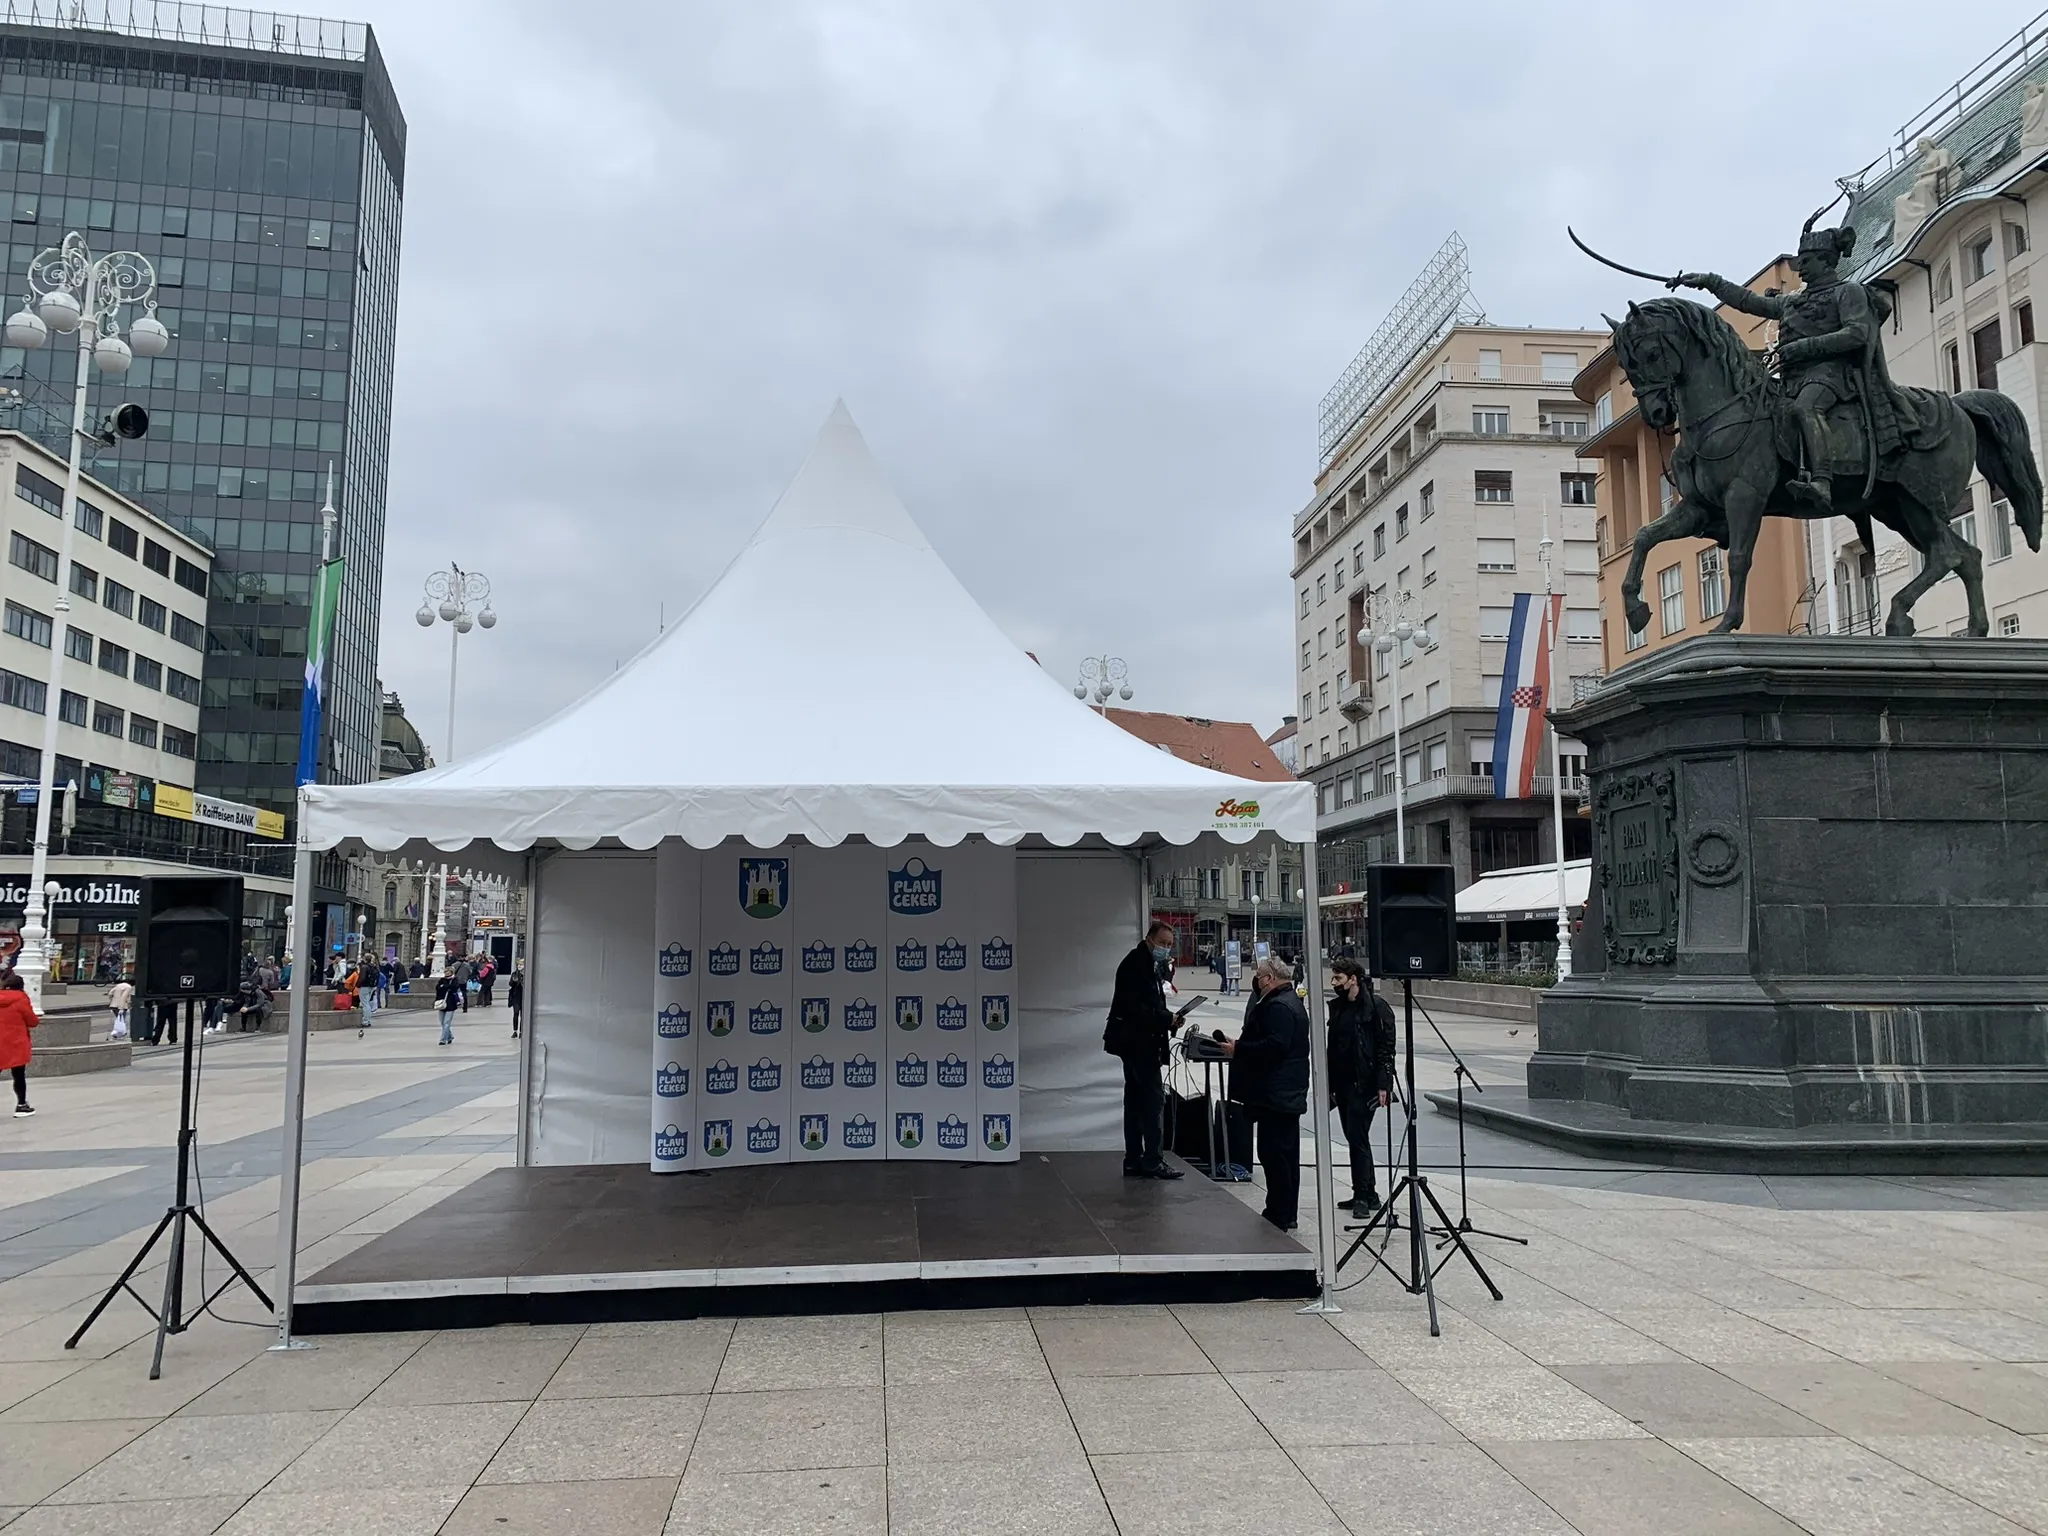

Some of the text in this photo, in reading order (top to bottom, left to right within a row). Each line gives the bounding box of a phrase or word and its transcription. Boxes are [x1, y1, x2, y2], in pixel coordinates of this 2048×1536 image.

[202, 804, 234, 823] Raiffeisen
[235, 812, 254, 827] BANK
[1623, 821, 1646, 849] BAN
[894, 880, 936, 893] PLAVI
[893, 893, 937, 907] CEKER
[98, 922, 127, 932] TELE2
[712, 955, 736, 963] PLAVI
[753, 954, 779, 962] PLAVI
[848, 952, 873, 960] PLAVI
[899, 951, 924, 959] PLAVI
[662, 956, 688, 964] PLAVI
[805, 960, 832, 968] CEKER
[984, 957, 1010, 965] CEKER
[661, 964, 688, 972] CEKER
[753, 962, 780, 970] CEKER
[660, 1017, 686, 1025] PLAVI
[752, 1013, 778, 1022] PLAVI
[939, 1017, 964, 1025] CEKER
[752, 1022, 779, 1030] CEKER
[847, 1018, 874, 1026] CEKER
[660, 1025, 687, 1033] CEKER
[804, 1068, 830, 1076] PLAVI
[847, 1067, 873, 1075] PLAVI
[900, 1066, 924, 1074] PLAVI
[940, 1067, 964, 1075] PLAVI
[986, 1067, 1011, 1075] PLAVI
[709, 1072, 734, 1081] PLAVI
[752, 1070, 777, 1079] PLAVI
[899, 1074, 925, 1082] CEKER
[659, 1076, 685, 1084] PLAVI
[751, 1079, 778, 1087] CEKER
[804, 1076, 831, 1084] CEKER
[847, 1075, 873, 1083] CEKER
[939, 1075, 964, 1083] CEKER
[985, 1075, 1012, 1083] CEKER
[658, 1084, 686, 1092] CEKER
[709, 1081, 735, 1090] CEKER
[847, 1127, 872, 1135] PLAVI
[940, 1128, 964, 1136] PLAVI
[750, 1131, 776, 1140] PLAVI
[846, 1135, 873, 1143] CEKER
[658, 1138, 684, 1147] PLAVI
[750, 1140, 777, 1148] CEKER
[940, 1136, 965, 1144] CEKER
[657, 1147, 684, 1155] CEKER
